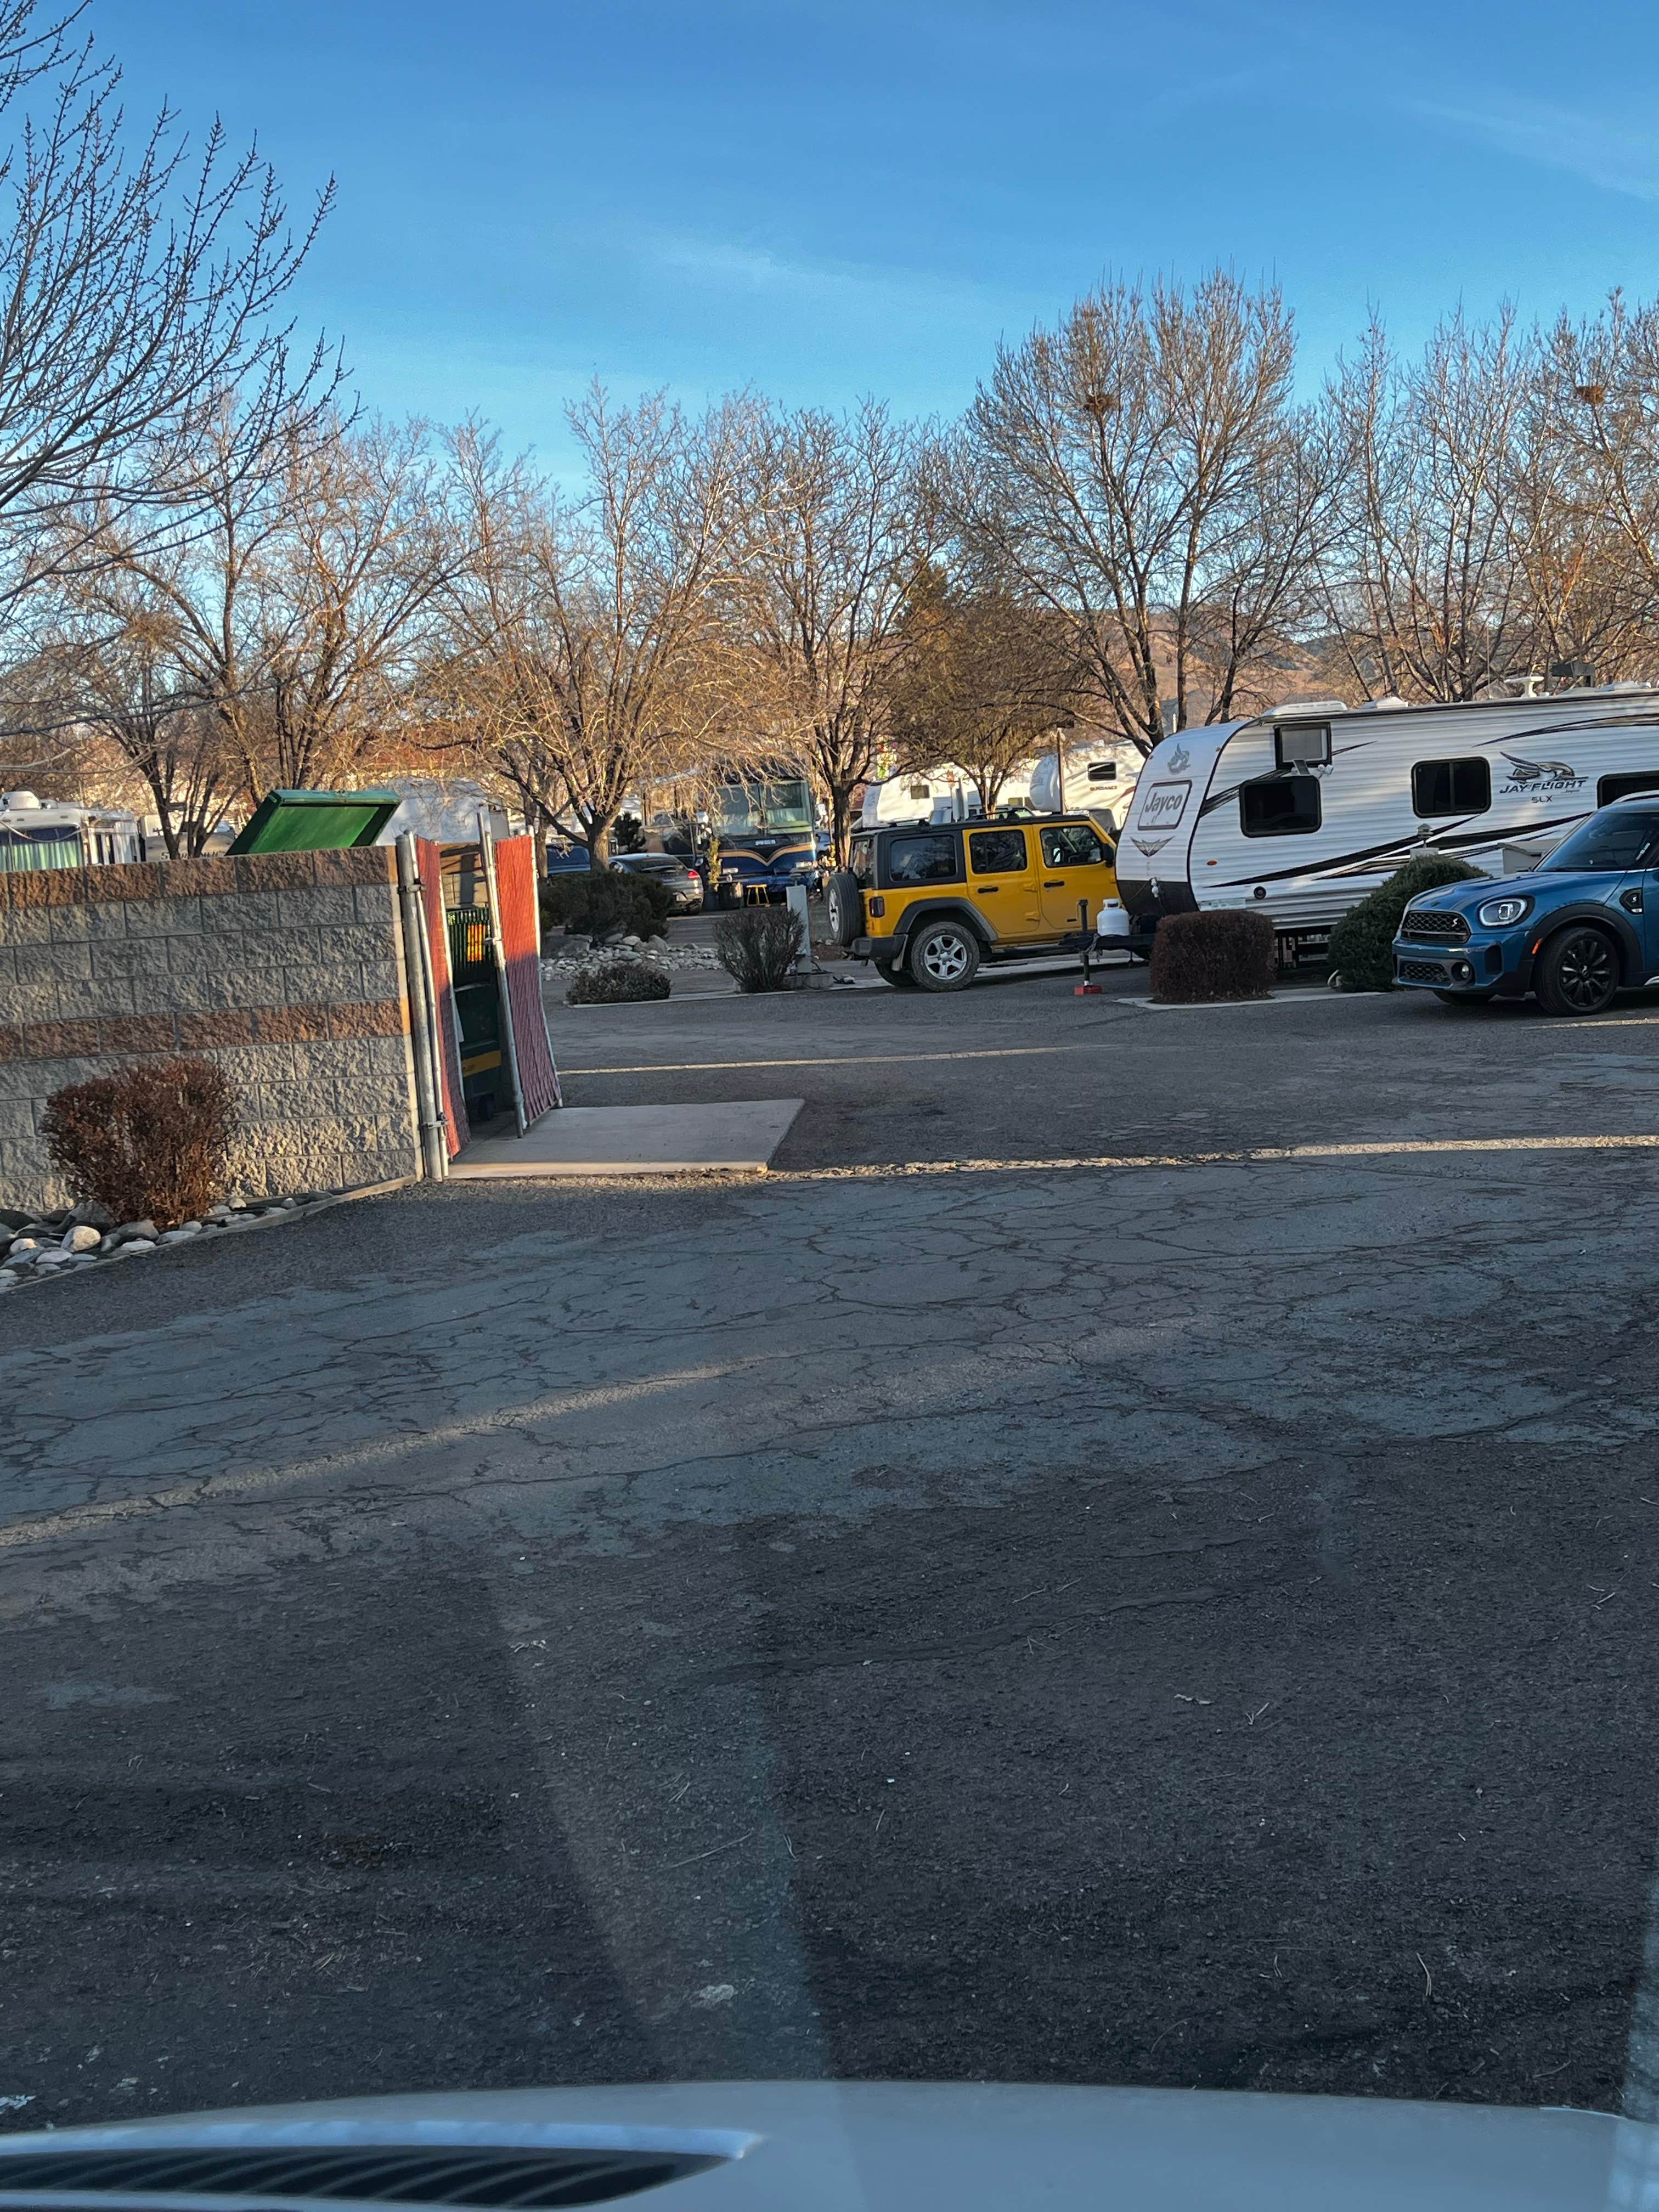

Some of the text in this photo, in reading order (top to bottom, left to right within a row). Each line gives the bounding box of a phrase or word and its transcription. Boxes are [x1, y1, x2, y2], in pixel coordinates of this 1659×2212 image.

[1499, 780, 1587, 793] JAY FLIGHT
[1144, 792, 1183, 816] Jayco
